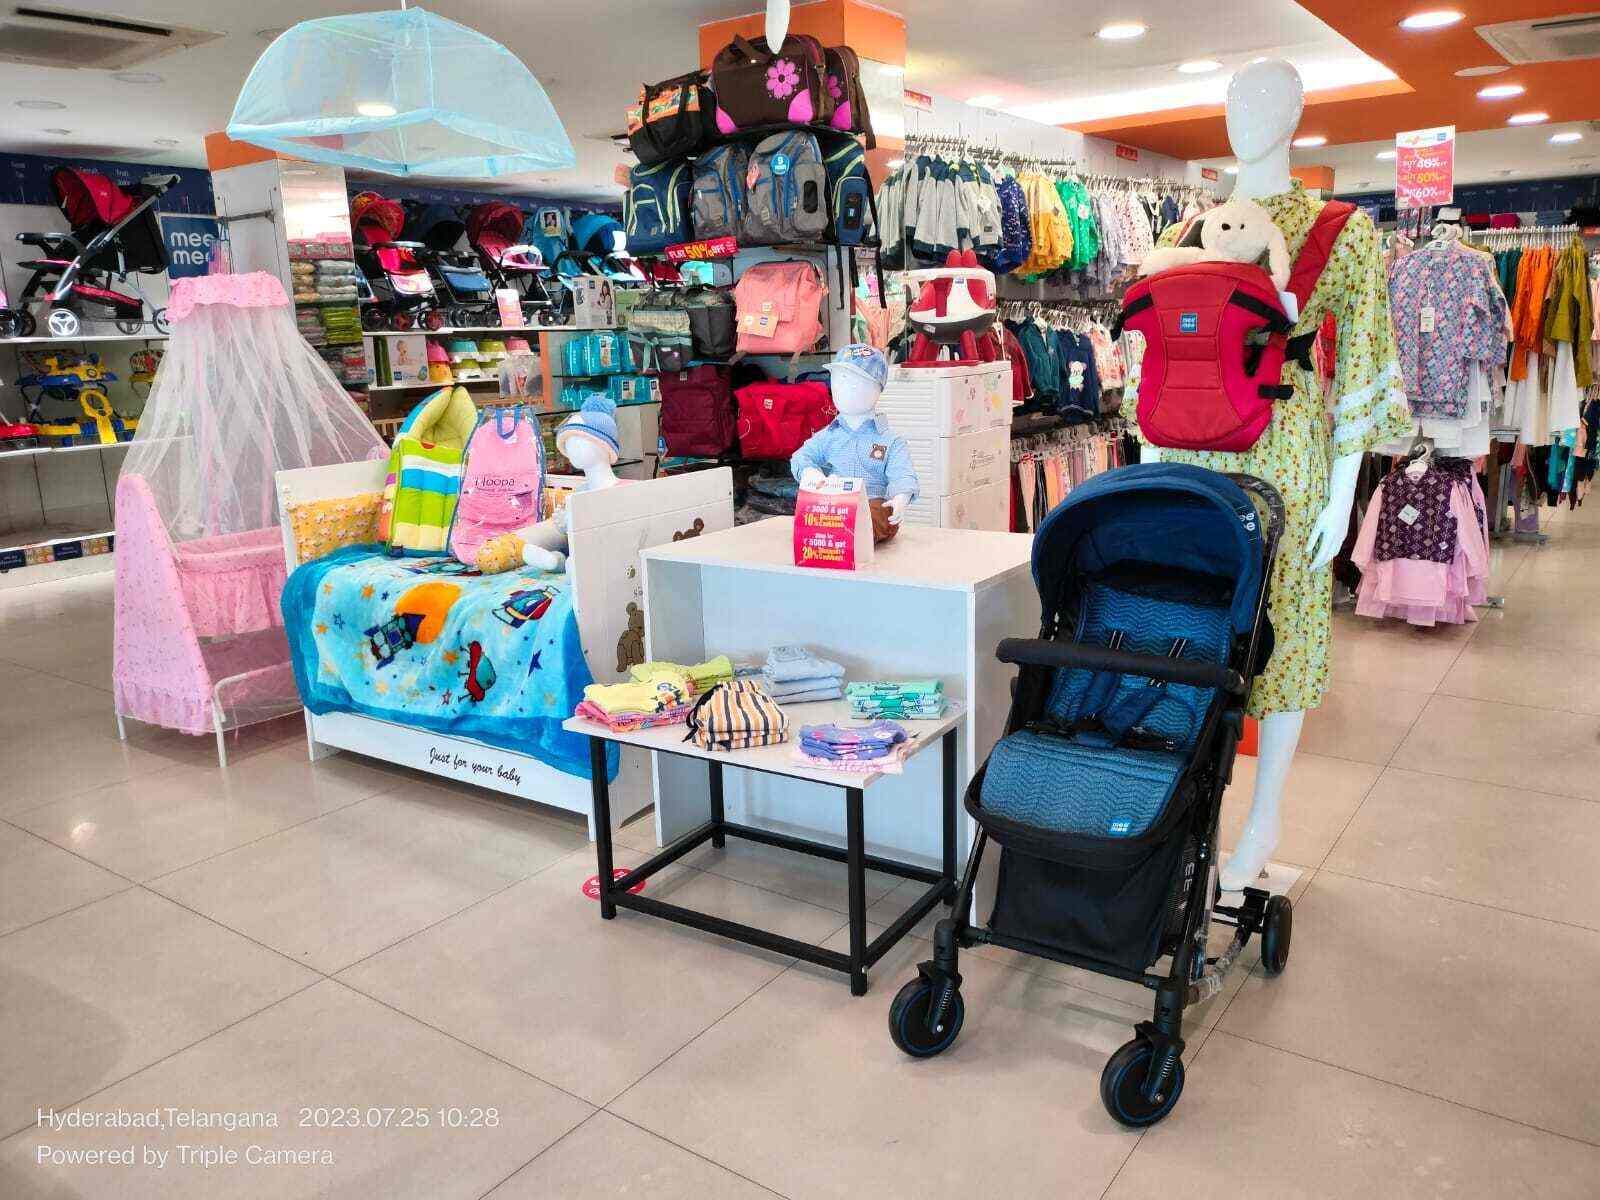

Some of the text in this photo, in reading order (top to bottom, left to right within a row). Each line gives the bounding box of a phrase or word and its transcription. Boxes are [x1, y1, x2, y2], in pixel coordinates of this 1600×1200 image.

[173, 250, 209, 265] me
[683, 243, 715, 259] 50%
[430, 747, 521, 785] Just for your baby
